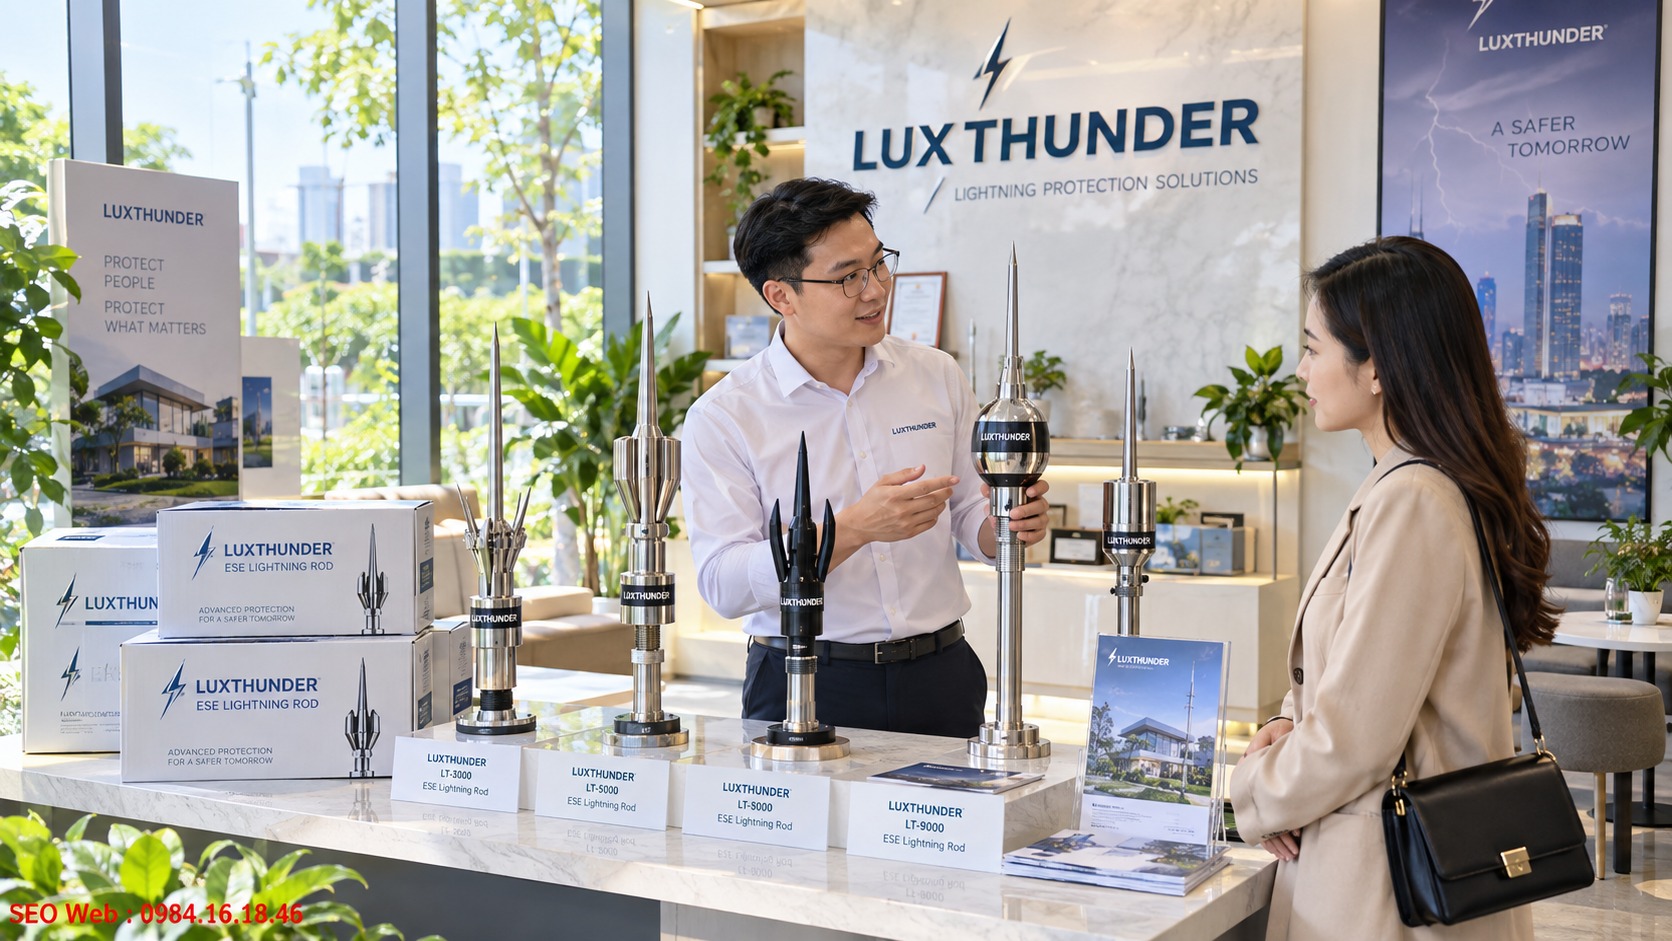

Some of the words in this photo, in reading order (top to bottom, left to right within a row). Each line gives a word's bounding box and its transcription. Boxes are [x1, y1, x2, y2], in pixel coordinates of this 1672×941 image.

[1479, 25, 1604, 51] LUXTHUNDER
[1491, 121, 1504, 137] A
[1512, 116, 1575, 134] SAFER
[1508, 135, 1630, 158] TOMORROW
[955, 183, 1036, 201] LIGHTNING
[1044, 176, 1147, 195] PROTECTION
[1156, 169, 1258, 189] SOLUTIONS
[104, 204, 203, 226] LUXTHUNDER
[105, 255, 164, 271] PROTECT
[105, 275, 154, 289] PEOPLE
[105, 301, 164, 314] PROTECT
[105, 320, 144, 332] WHAT
[149, 322, 206, 334] MATTERS
[892, 422, 936, 434] LUXTHUNDER
[979, 432, 1032, 442] LUXTHUNDER
[225, 543, 332, 556] LUXTHUNDER
[224, 563, 245, 573] ESE
[248, 562, 308, 573] LIGHTNING
[310, 561, 334, 571] ROD
[198, 606, 242, 615] ADVANCED
[244, 605, 295, 614] PROTECTION
[198, 615, 216, 625] FOR
[216, 615, 222, 623] A
[223, 615, 248, 623] SAFER
[248, 614, 296, 623] TOMORROW
[1117, 655, 1169, 666] LUXTHUNDER
[197, 678, 317, 693] LUXTHUNDER
[196, 701, 219, 711] ESE
[223, 700, 289, 711] LIGHTNING
[292, 699, 319, 709] ROD
[167, 747, 216, 757] ADVANCED
[217, 746, 273, 756] PROTECTION
[167, 757, 185, 767] FOR
[187, 757, 194, 765] A
[195, 757, 222, 766] SAFER
[224, 756, 274, 765] TOMORROW
[428, 754, 486, 766] LUXTHUNDER
[440, 770, 472, 781] LT-3000
[573, 767, 634, 781] LUXTHUNDER
[422, 781, 437, 791] ESE
[439, 784, 472, 795] Lightning
[473, 786, 489, 796] Rod
[723, 783, 789, 798] LUXTHUNDER
[567, 796, 582, 806] ESE
[584, 799, 618, 811] Lightning
[620, 802, 637, 812] Rod
[889, 801, 962, 818] LUXTHUNDER
[717, 814, 733, 824] ESE
[736, 816, 773, 830] Lightning
[775, 821, 793, 831] Rod
[906, 820, 944, 832] LT-9000
[883, 834, 901, 845] ESE
[903, 837, 944, 852] Lightning
[947, 842, 966, 853] Rod
